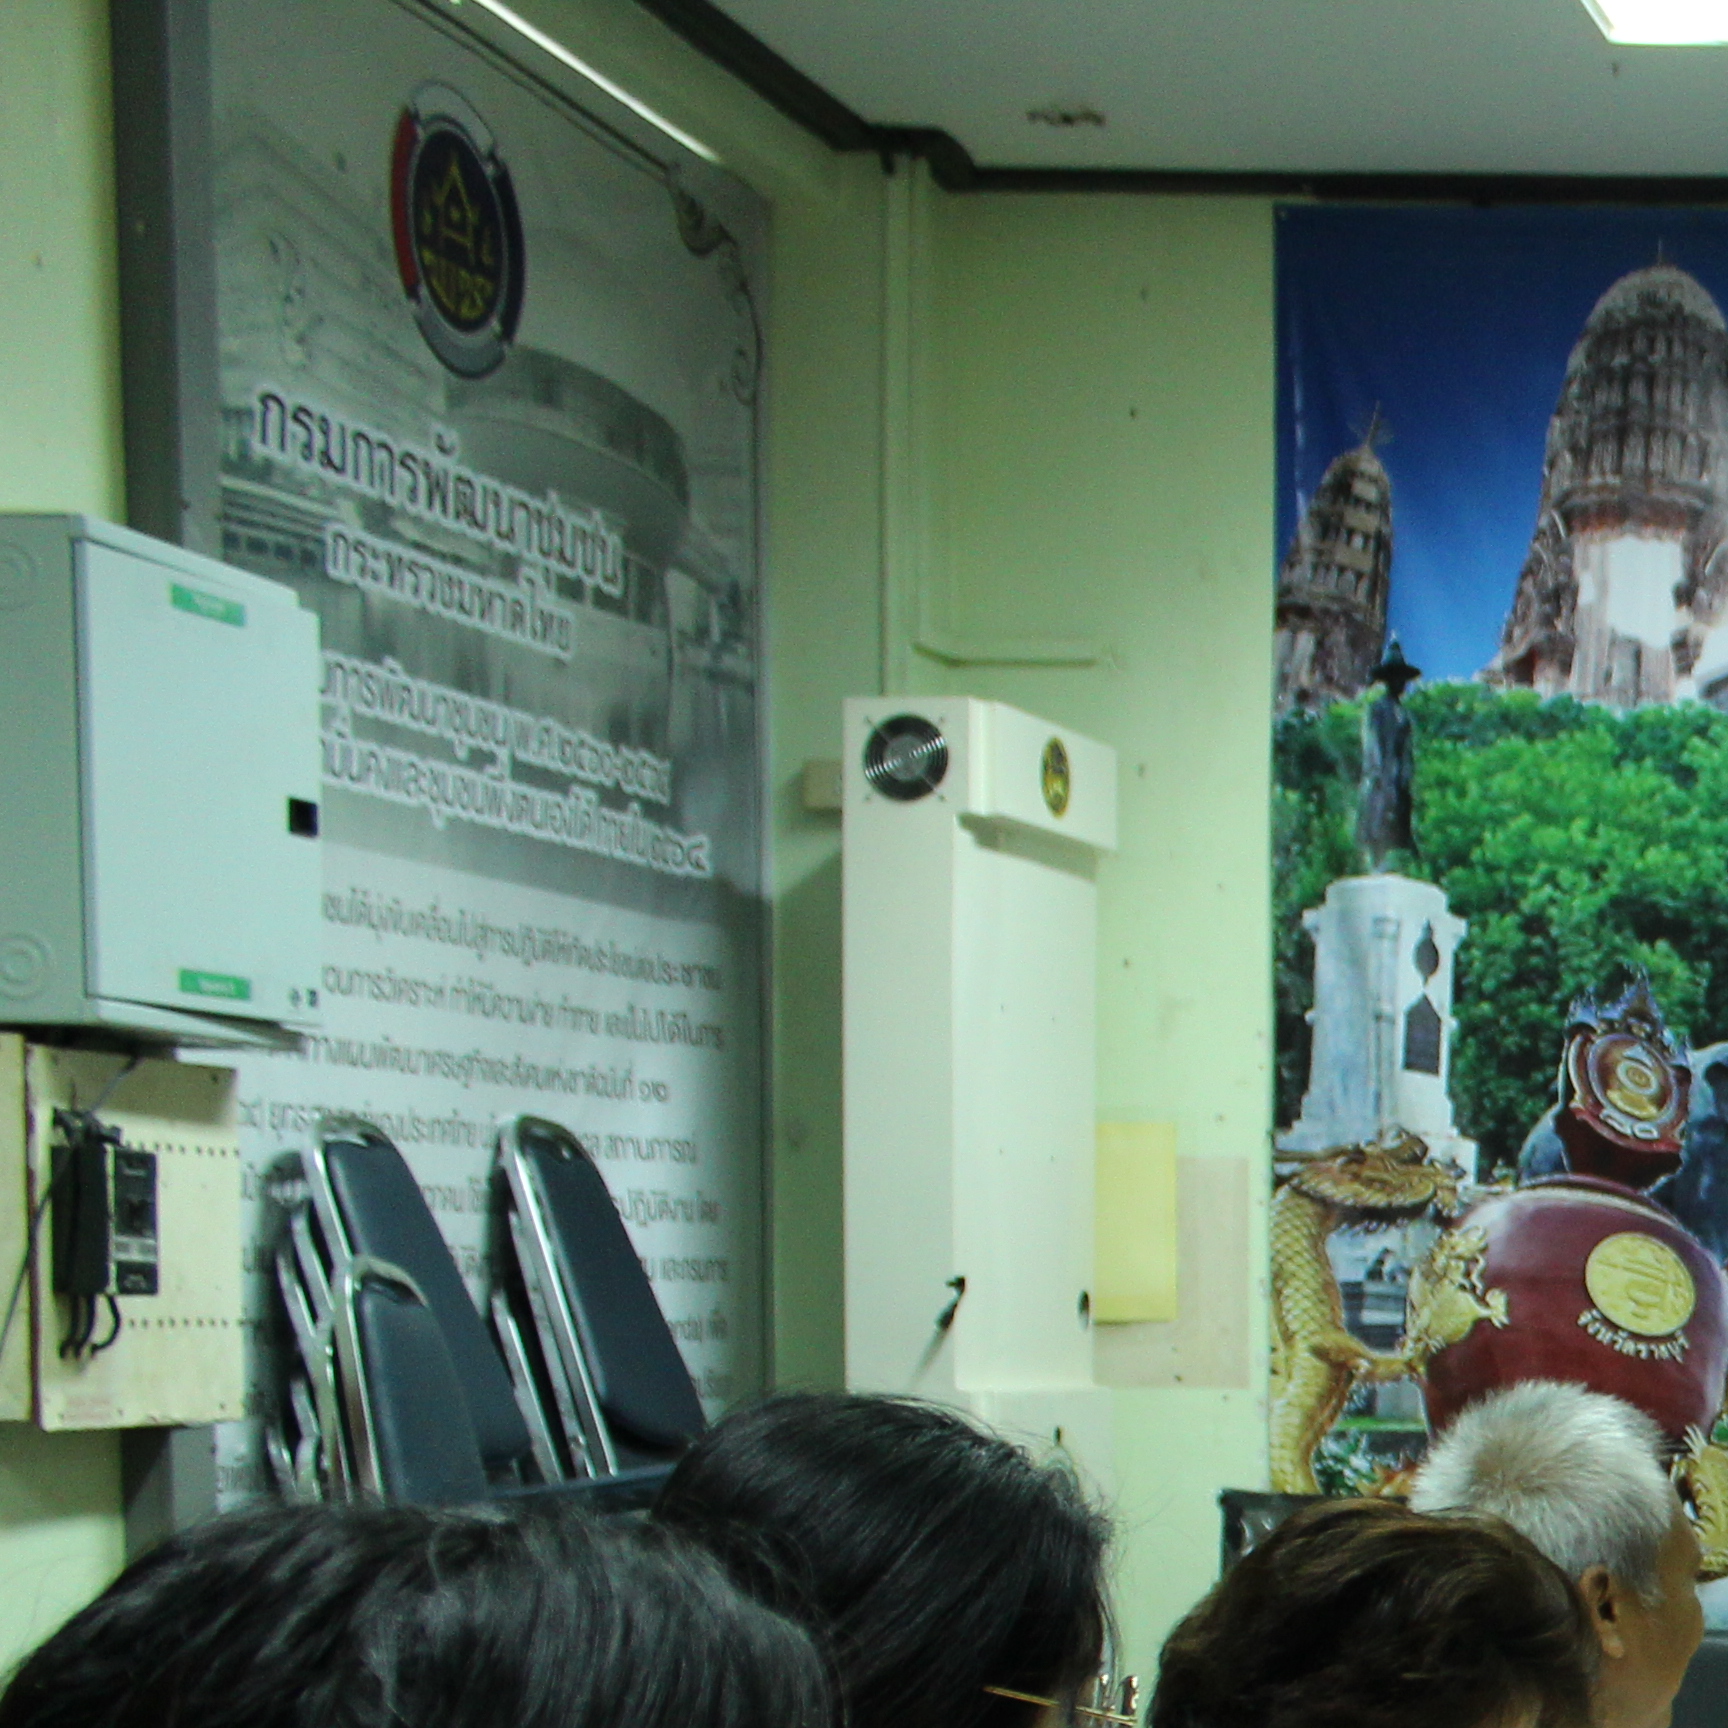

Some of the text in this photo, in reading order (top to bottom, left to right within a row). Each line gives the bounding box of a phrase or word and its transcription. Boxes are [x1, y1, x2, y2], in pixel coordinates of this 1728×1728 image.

[258, 390, 624, 598] กรมการพัฒนาชุมชน
[328, 530, 570, 657] กระทรวงมหาดไทย
